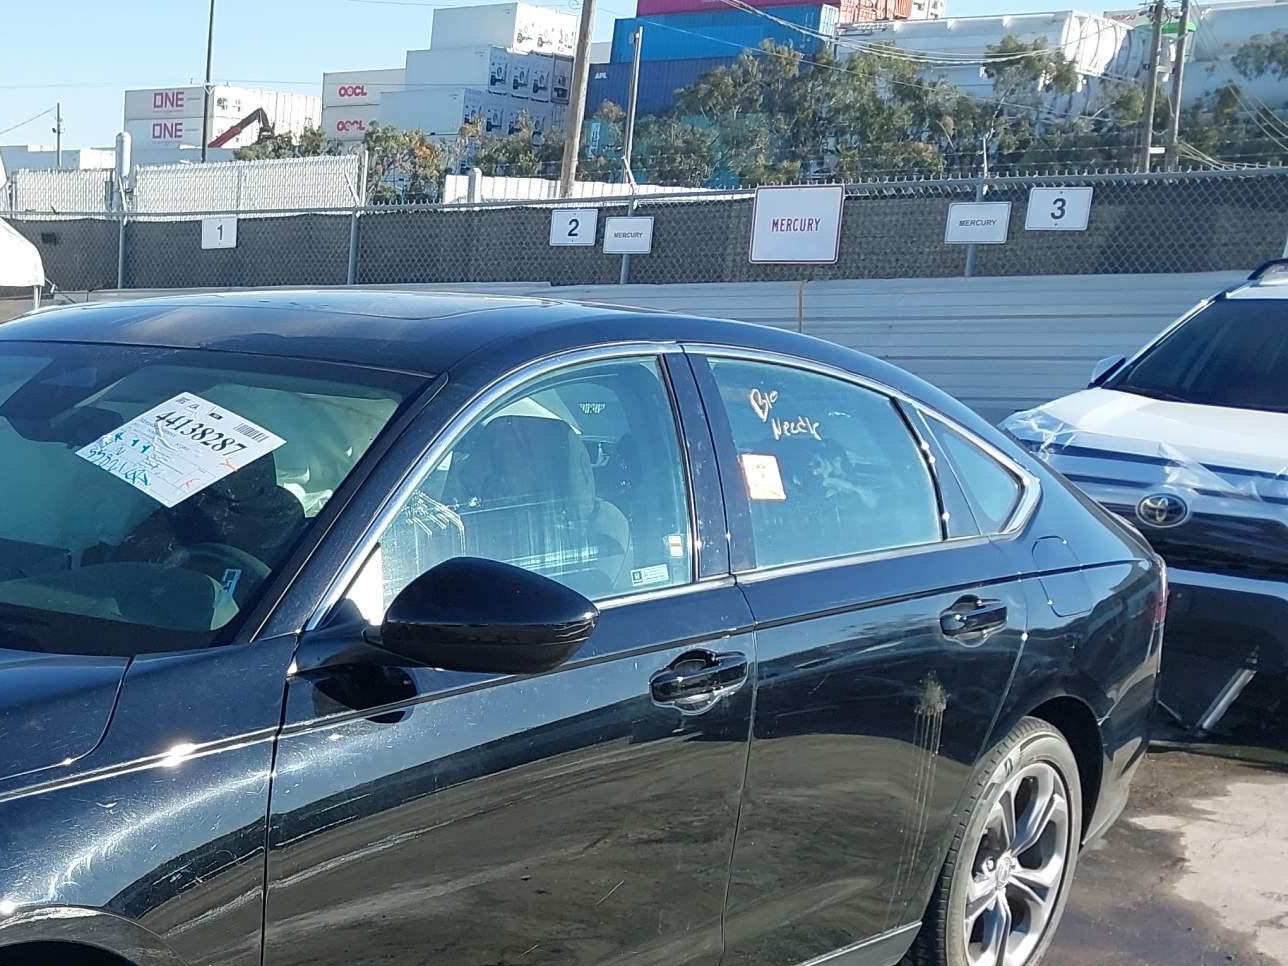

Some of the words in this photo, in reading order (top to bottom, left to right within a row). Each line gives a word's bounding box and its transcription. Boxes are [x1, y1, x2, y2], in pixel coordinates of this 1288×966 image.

[153, 91, 185, 109] ONE
[338, 85, 368, 98] OOCL
[152, 122, 184, 139] ONE
[1050, 197, 1067, 220] 3
[567, 218, 580, 237] 2
[771, 216, 822, 233] MERCURY
[958, 218, 998, 228] MERCURY
[216, 224, 223, 241] 1
[613, 231, 644, 239] MERCURY
[155, 411, 248, 457] 44138287
